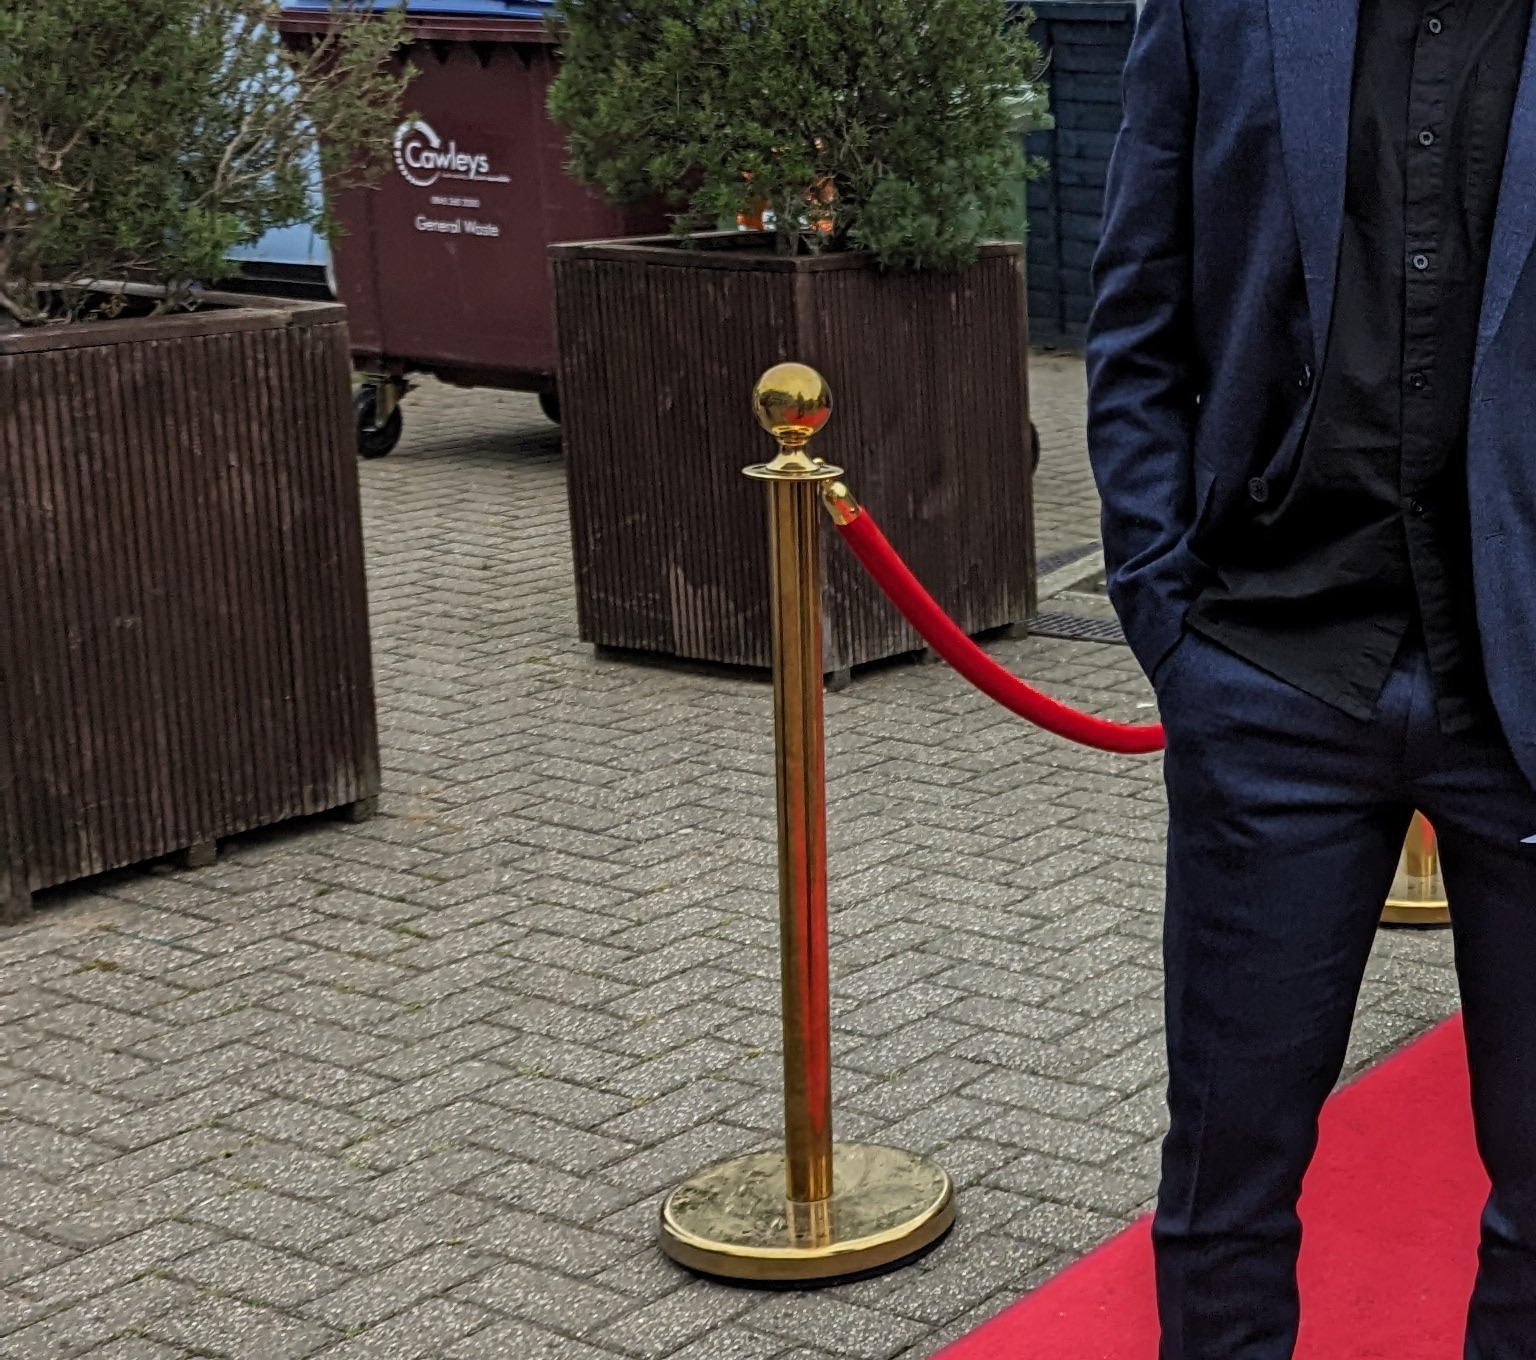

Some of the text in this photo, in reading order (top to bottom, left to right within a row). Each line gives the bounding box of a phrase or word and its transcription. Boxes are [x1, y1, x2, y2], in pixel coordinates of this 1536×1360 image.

[405, 142, 489, 179] Cawleys
[415, 215, 500, 237] General Waste
